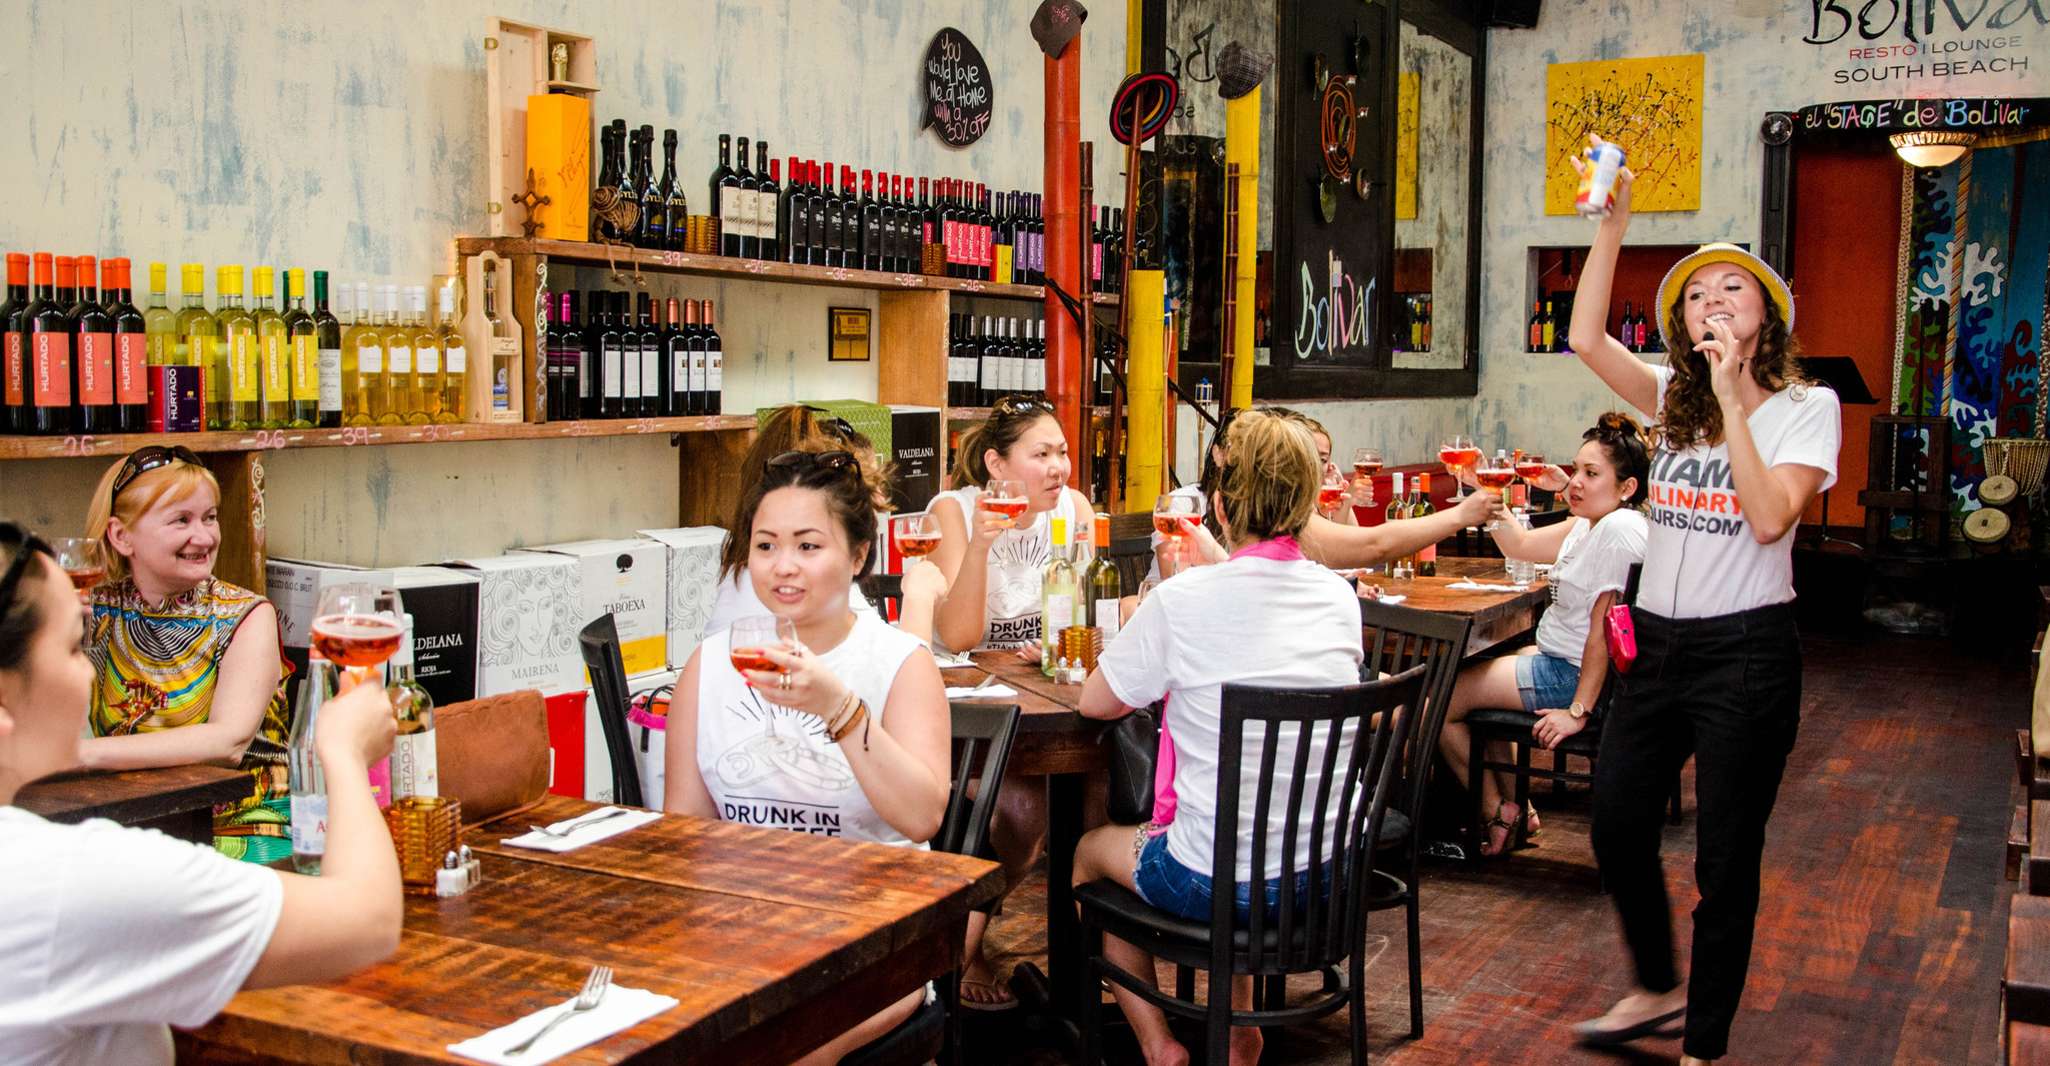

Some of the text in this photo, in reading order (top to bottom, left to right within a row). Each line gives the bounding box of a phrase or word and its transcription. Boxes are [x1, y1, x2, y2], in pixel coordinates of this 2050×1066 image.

[1849, 35, 2023, 61] RESTO LOUNGE
[1833, 56, 2029, 84] SOUTH BEACH
[1903, 99, 1938, 127] de
[11, 335, 20, 392] HURTADO
[40, 334, 49, 392] HURTADO
[84, 335, 94, 391] HURTADO
[121, 335, 131, 391] HURTADO
[170, 367, 178, 420] HURTADO
[64, 435, 95, 457] 26
[255, 429, 286, 449] 26
[342, 426, 369, 446] 39
[990, 615, 1042, 634] DRUNK
[415, 633, 464, 651] DELANA
[511, 663, 560, 681] MAIRENA
[724, 802, 840, 827] DRUNK IN
